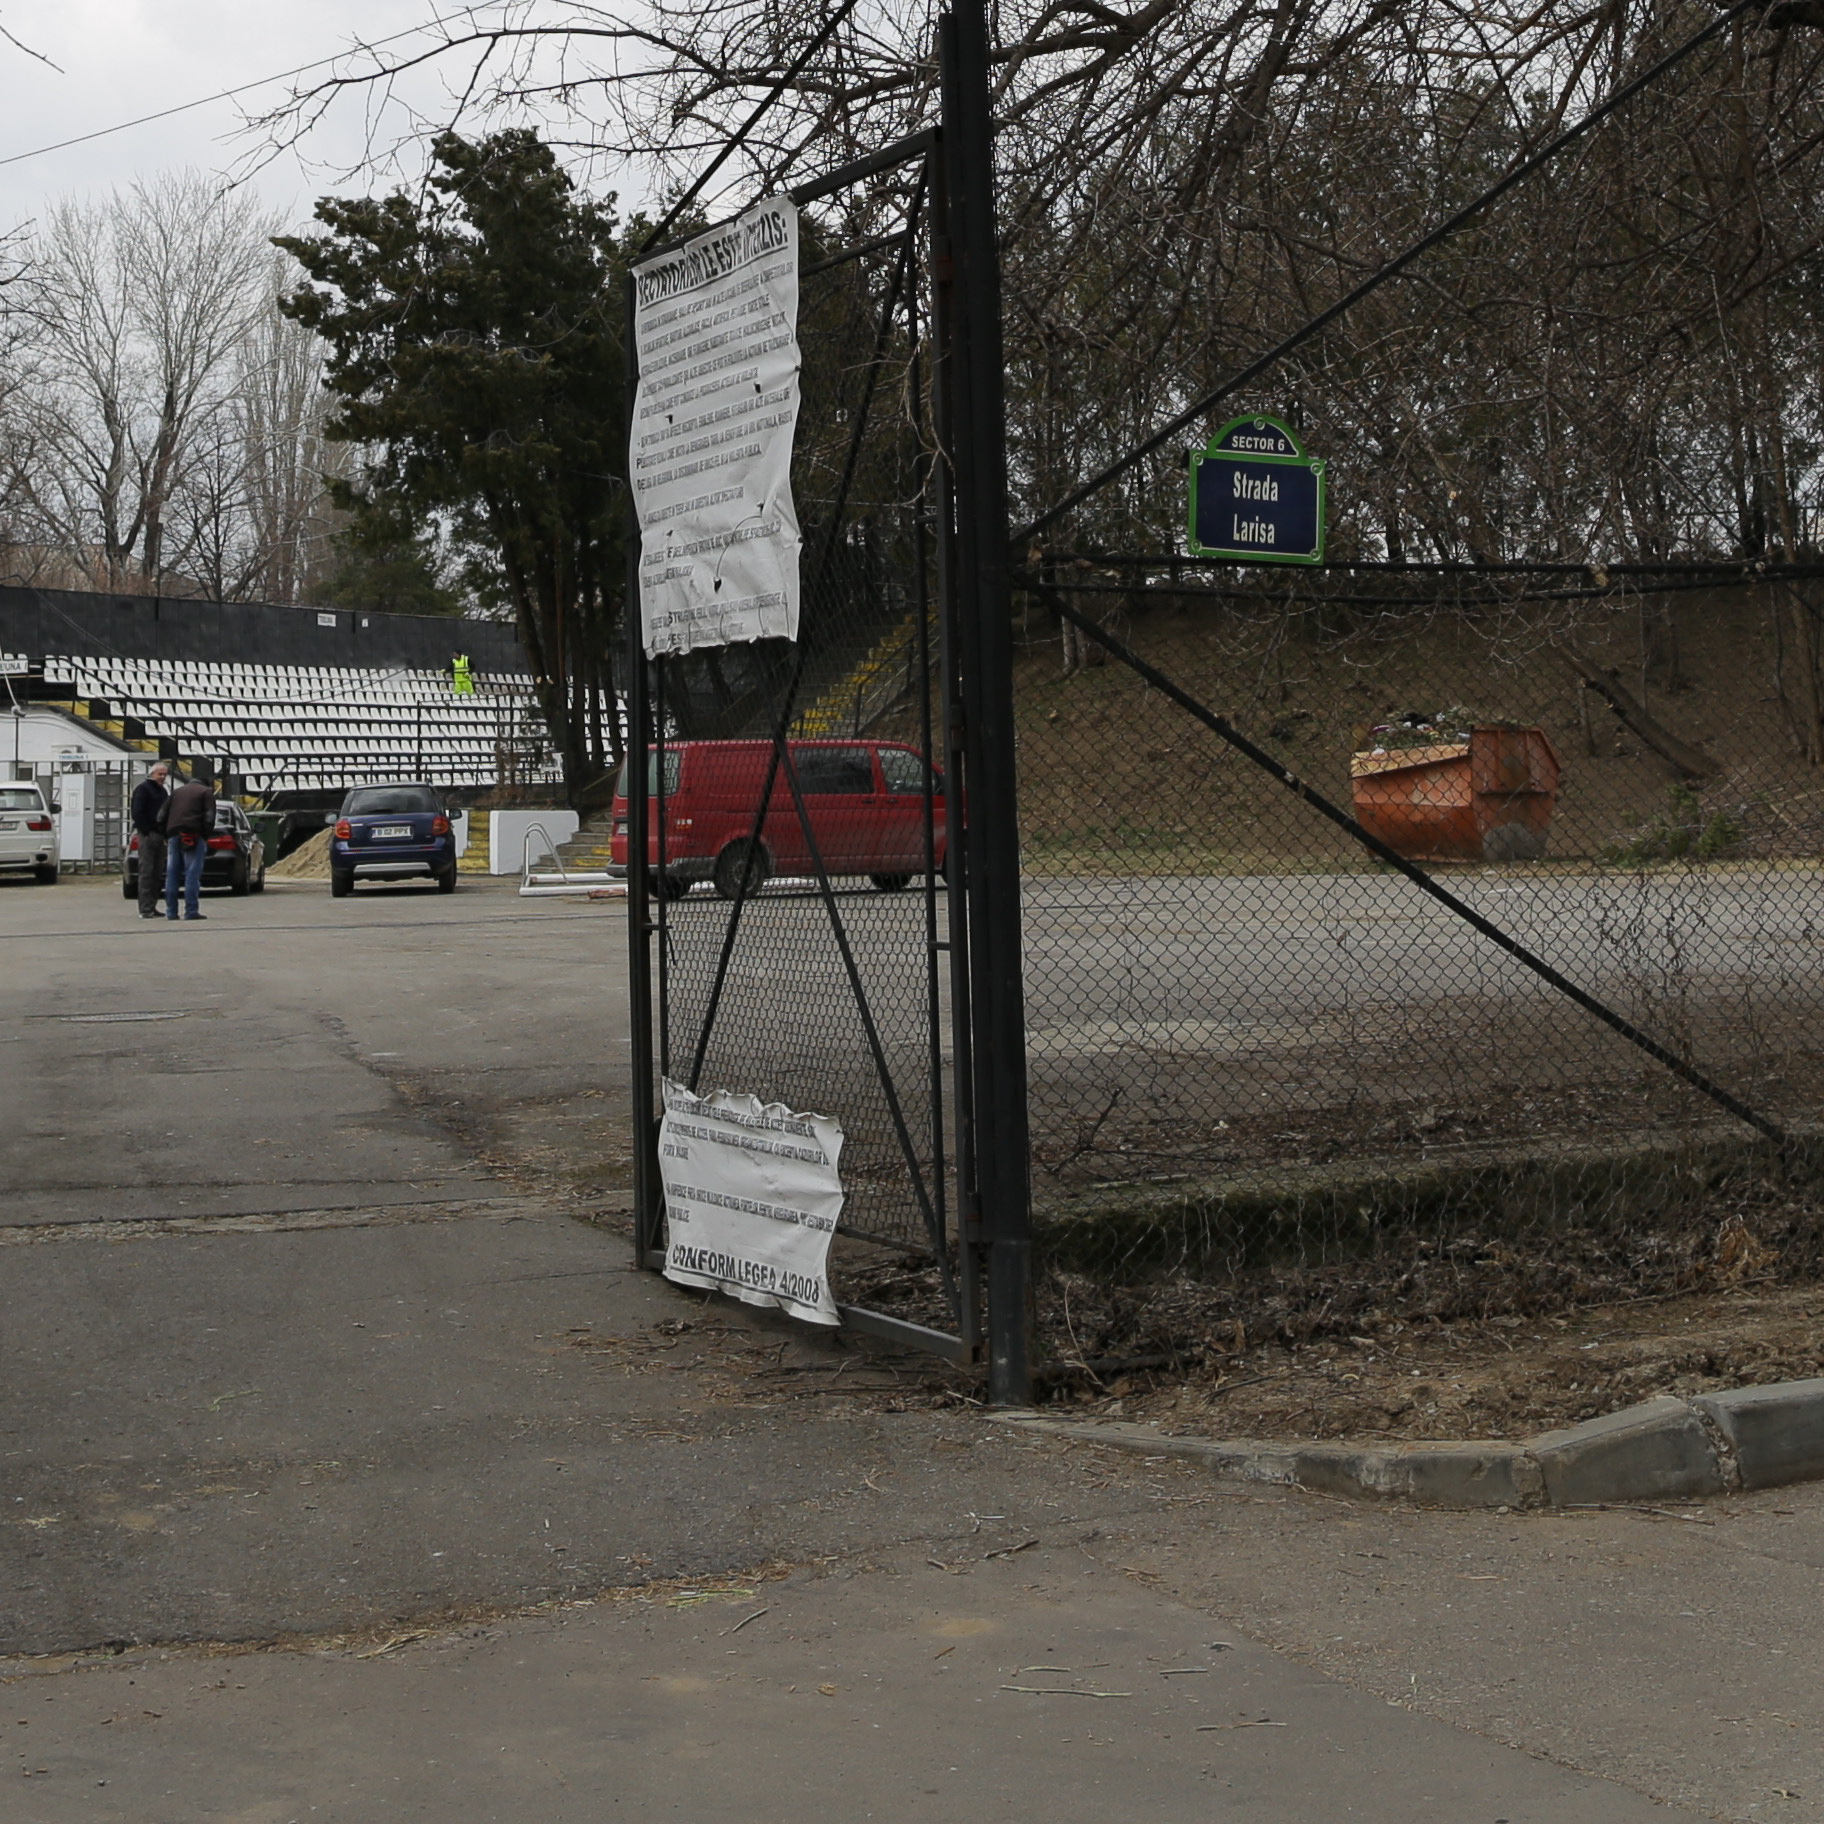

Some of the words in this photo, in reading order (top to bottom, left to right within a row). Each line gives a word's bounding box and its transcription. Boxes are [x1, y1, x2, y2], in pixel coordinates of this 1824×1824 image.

[712, 231, 743, 272] ESTE
[1231, 435, 1274, 450] SECTOR
[1277, 438, 1285, 451] 6
[1233, 471, 1278, 501] Strada
[1233, 513, 1275, 544] Larisa
[672, 1244, 736, 1276] CONFORM
[738, 1258, 775, 1291] LEGEA
